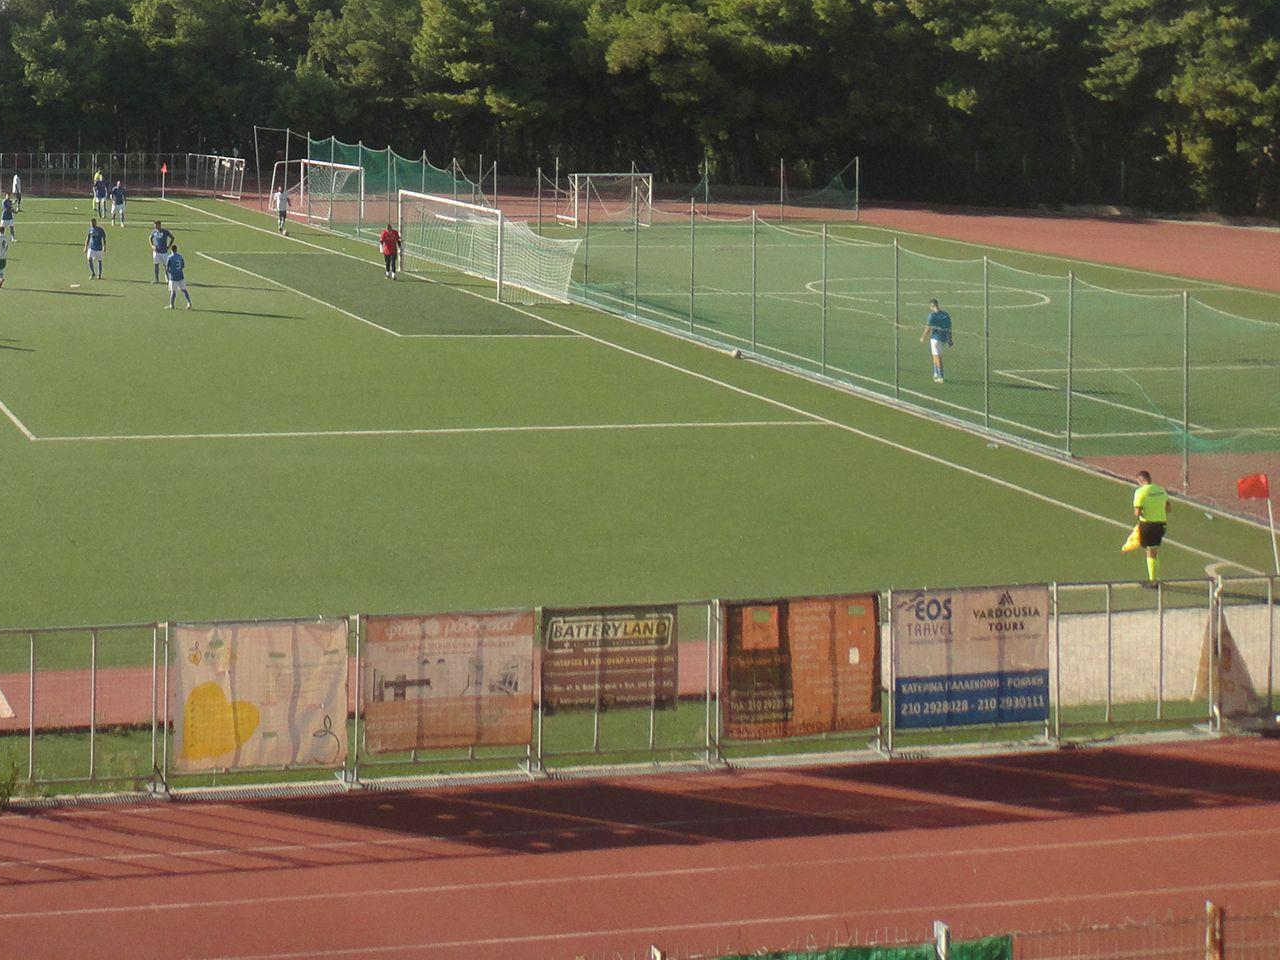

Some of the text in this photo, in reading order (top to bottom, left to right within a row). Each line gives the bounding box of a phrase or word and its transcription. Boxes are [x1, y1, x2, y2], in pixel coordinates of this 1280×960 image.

[915, 598, 952, 621] EOS
[973, 607, 1040, 619] VARDOUSIA
[553, 621, 667, 638] BATTERYLAND
[907, 623, 952, 637] TRAVEL
[988, 622, 1024, 632] TOURS
[901, 701, 921, 715] 210
[977, 697, 997, 711] 210
